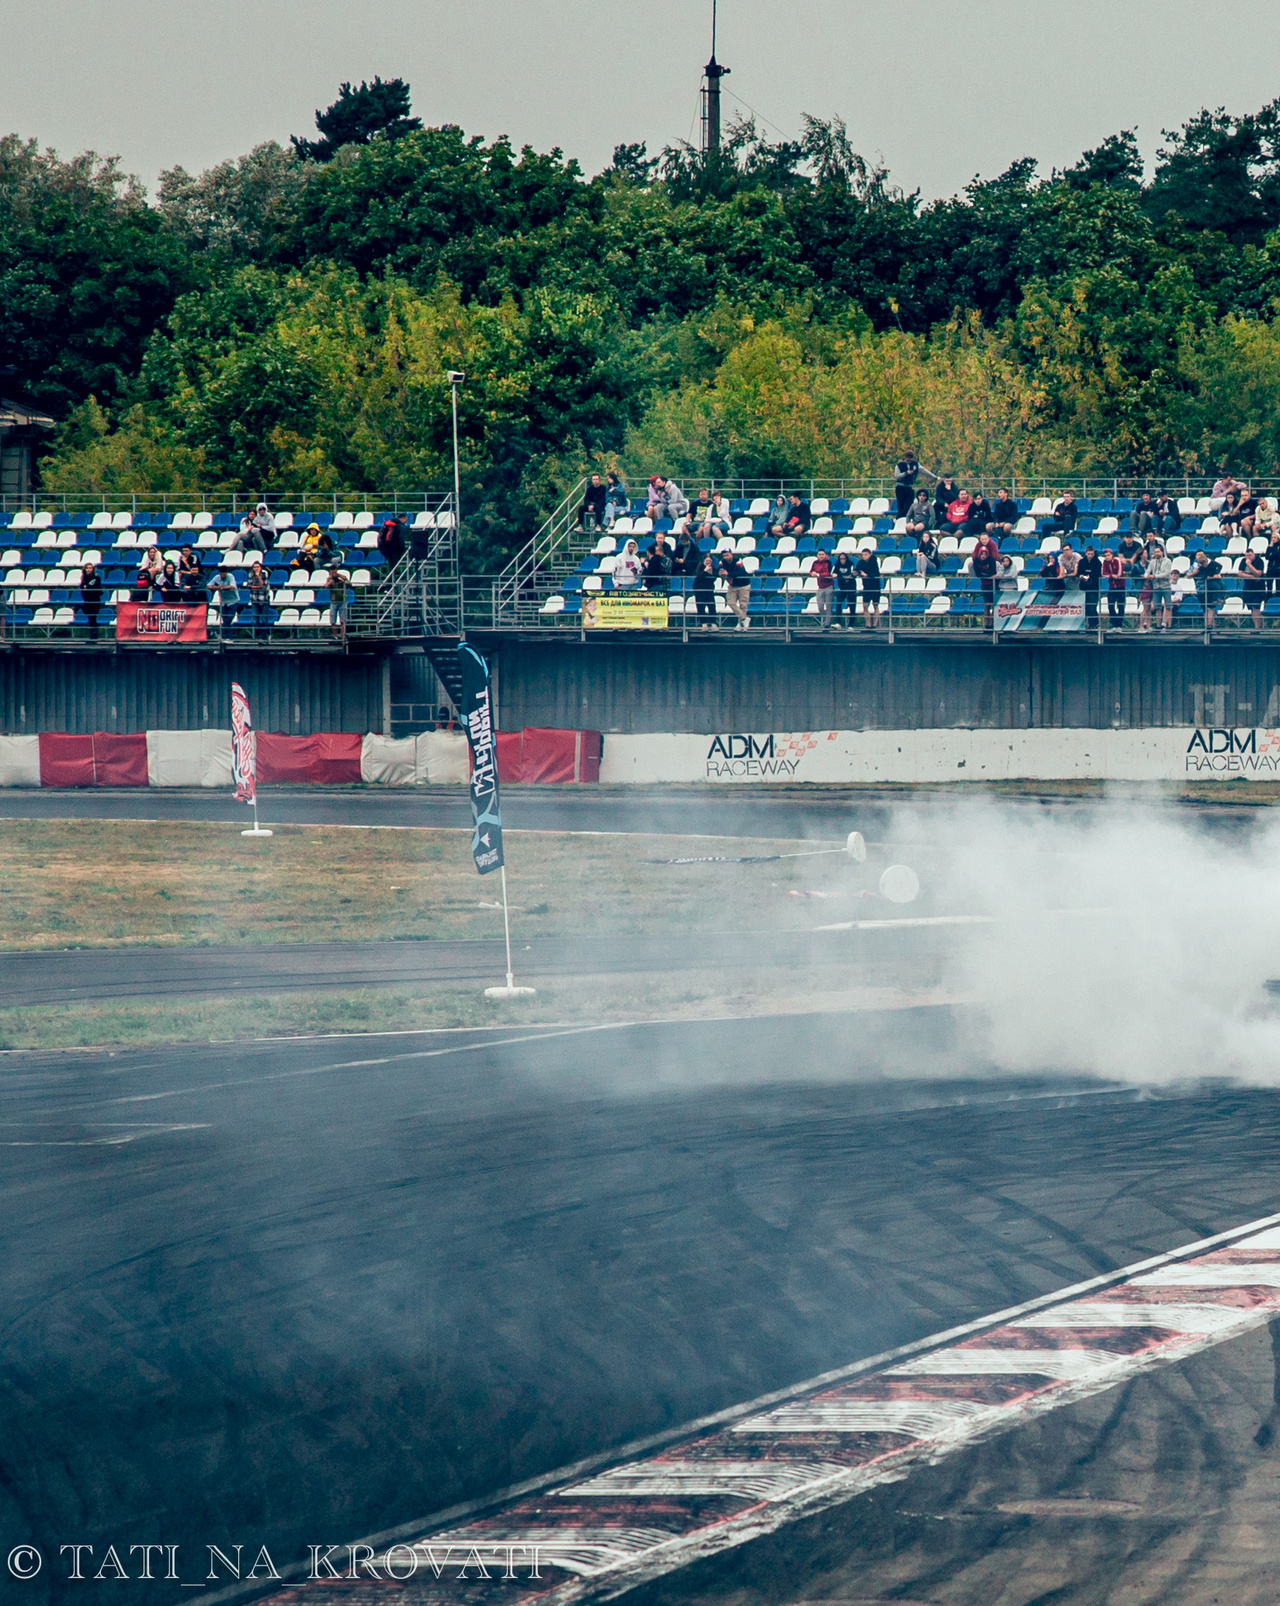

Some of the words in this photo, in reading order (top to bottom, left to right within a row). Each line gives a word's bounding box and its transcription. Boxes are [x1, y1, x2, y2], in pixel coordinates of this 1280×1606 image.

[160, 609, 186, 622] DRIFT
[160, 621, 178, 634] FUN
[707, 734, 774, 759] ADM
[1187, 729, 1256, 753] ADM
[706, 759, 800, 776] RACEWAY
